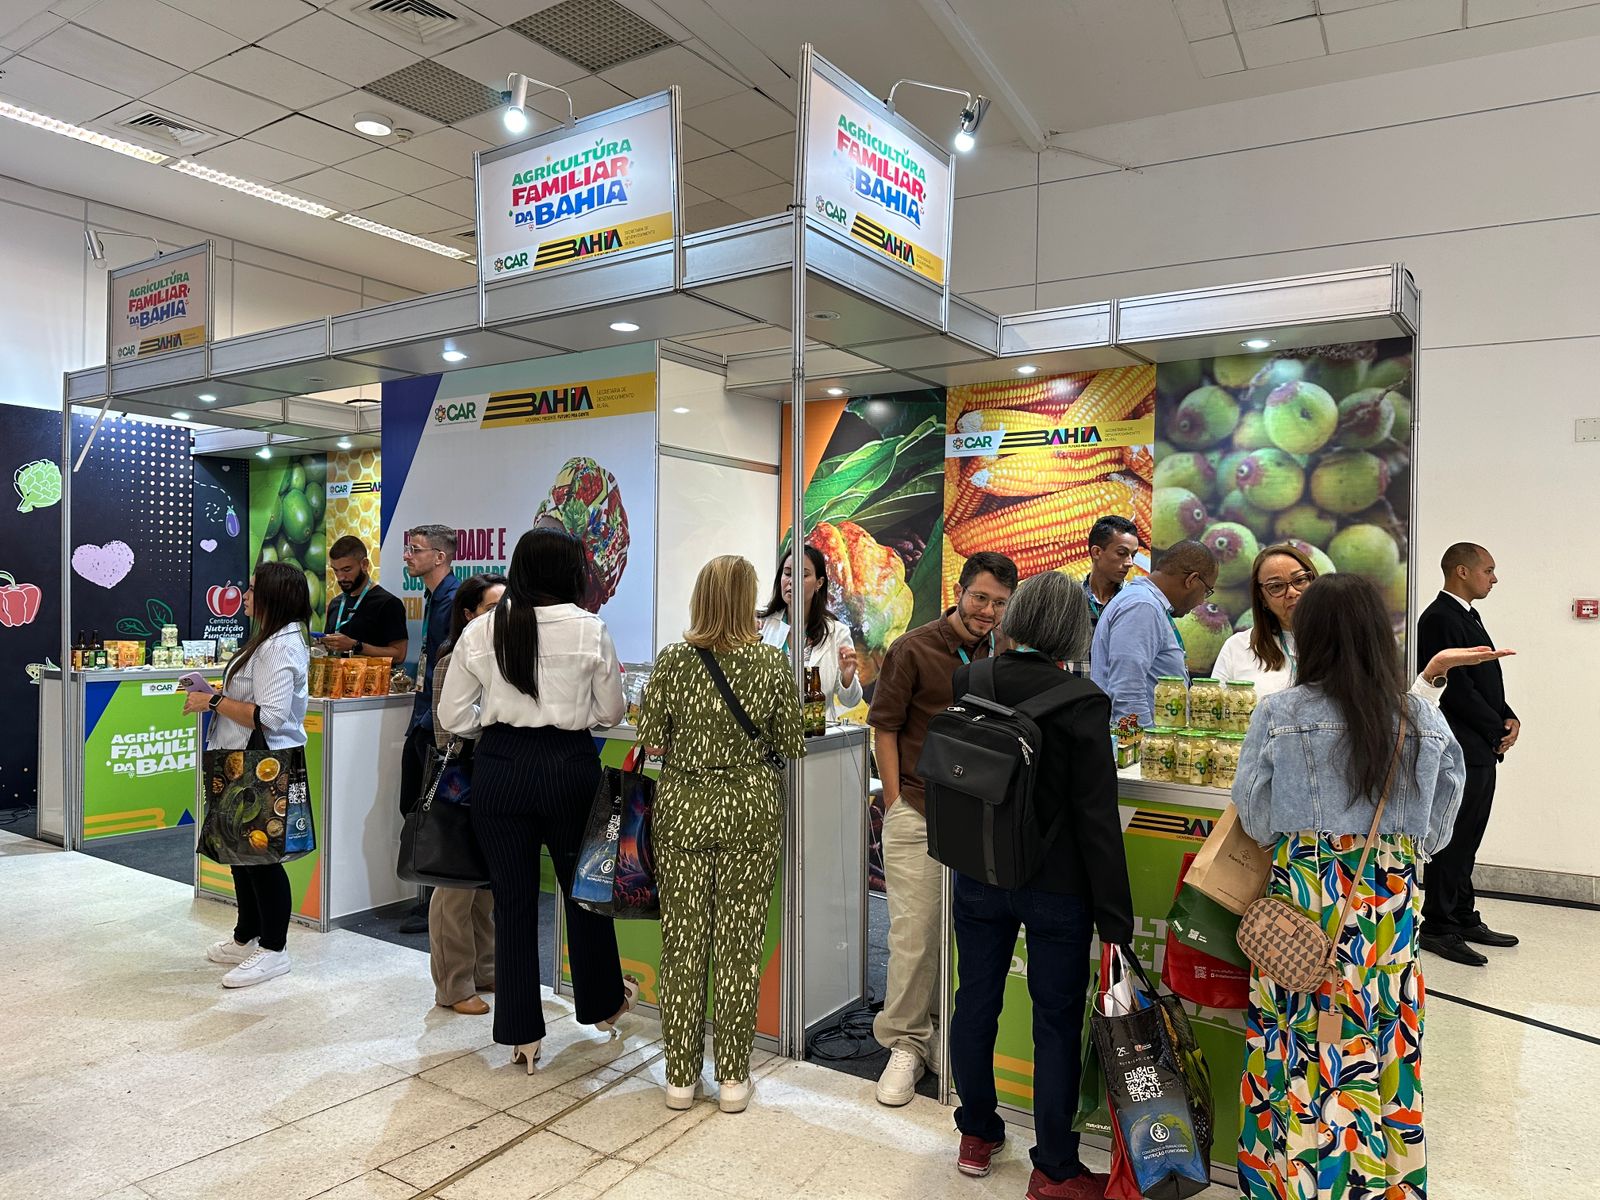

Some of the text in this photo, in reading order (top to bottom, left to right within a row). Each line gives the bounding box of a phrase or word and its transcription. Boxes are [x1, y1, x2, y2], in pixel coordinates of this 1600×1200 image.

[838, 114, 926, 183] AGRICULTURA
[512, 138, 632, 187] AGRICULTURA
[837, 129, 923, 203] FAMILIAR
[512, 156, 630, 207] FAMILIAR
[515, 179, 627, 226] DA BAHIA
[855, 166, 921, 226] BAHIA
[825, 200, 847, 226] CAR
[534, 228, 622, 268] BAHIA
[850, 215, 915, 266] BAHIA
[503, 252, 528, 270] CAR
[129, 272, 190, 298] AGRICULTURA
[128, 284, 188, 313] FAMILIAR
[130, 299, 187, 327] DA BAHIA
[122, 345, 135, 357] CAR
[138, 333, 182, 356] BAHIA
[446, 401, 477, 421] CAR
[483, 386, 594, 421] BAHIA
[964, 435, 993, 449] CAR
[997, 425, 1102, 449] BAHIA
[334, 485, 348, 494] CAR
[498, 527, 507, 560] E
[204, 625, 244, 633] Nutrição
[110, 727, 196, 745] AGRICULT
[110, 738, 195, 759] FAMILI
[113, 751, 196, 775] DA BAH
[1143, 1150, 1165, 1160] NUTRIÇÃO
